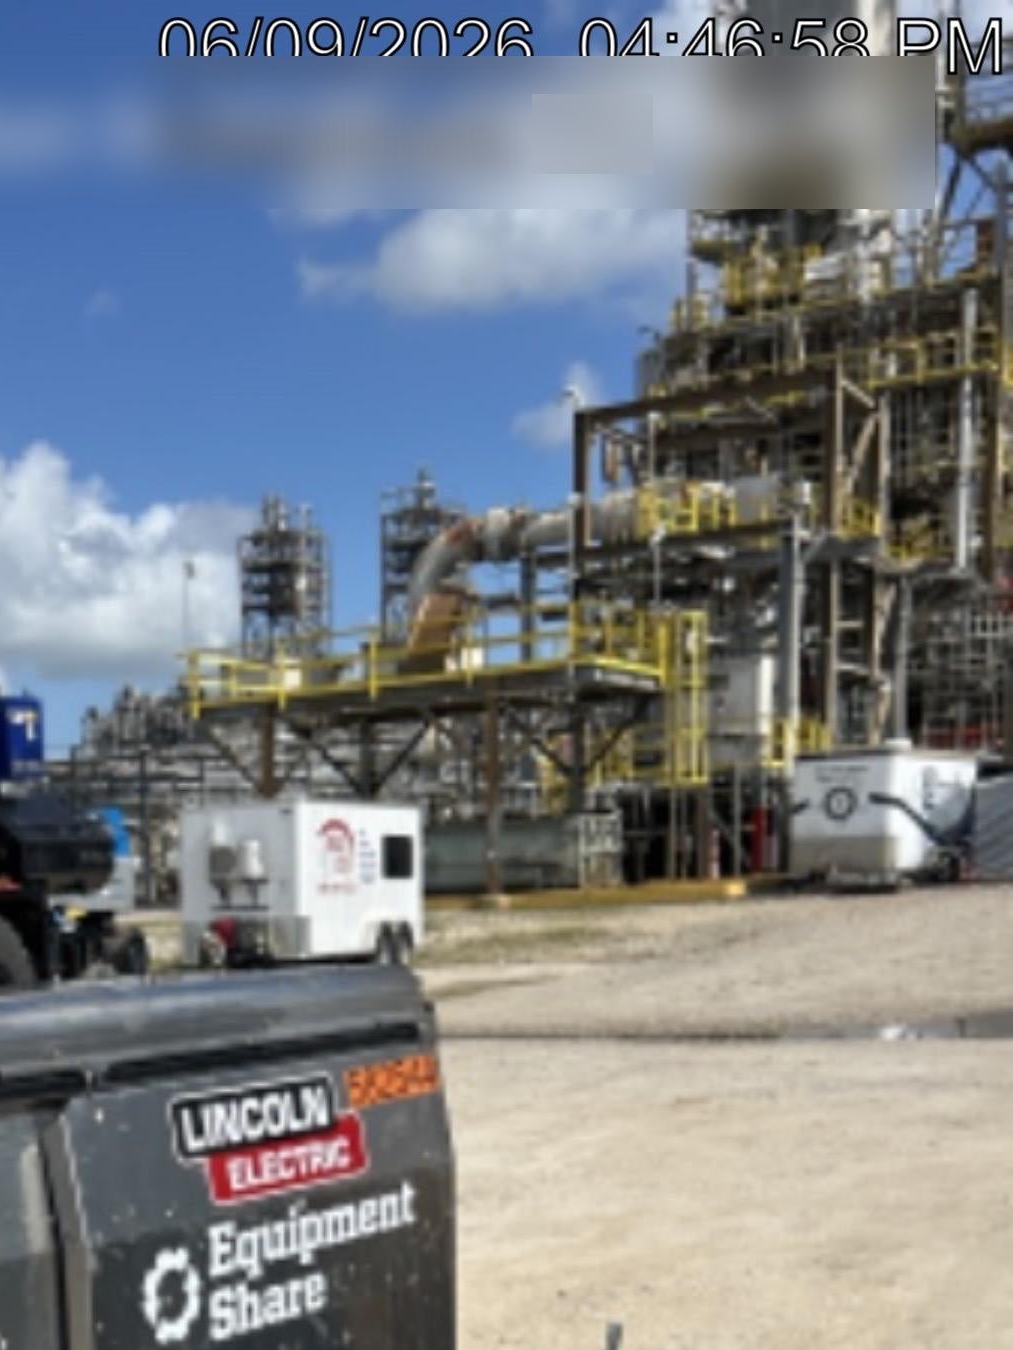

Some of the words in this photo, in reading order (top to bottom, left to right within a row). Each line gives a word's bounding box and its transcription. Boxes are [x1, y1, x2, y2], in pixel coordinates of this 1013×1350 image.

[179, 1084, 330, 1151] LINCOLN
[227, 1135, 351, 1191] ELECTRIC
[208, 1181, 416, 1278] Equipment
[208, 1271, 328, 1343] Share
